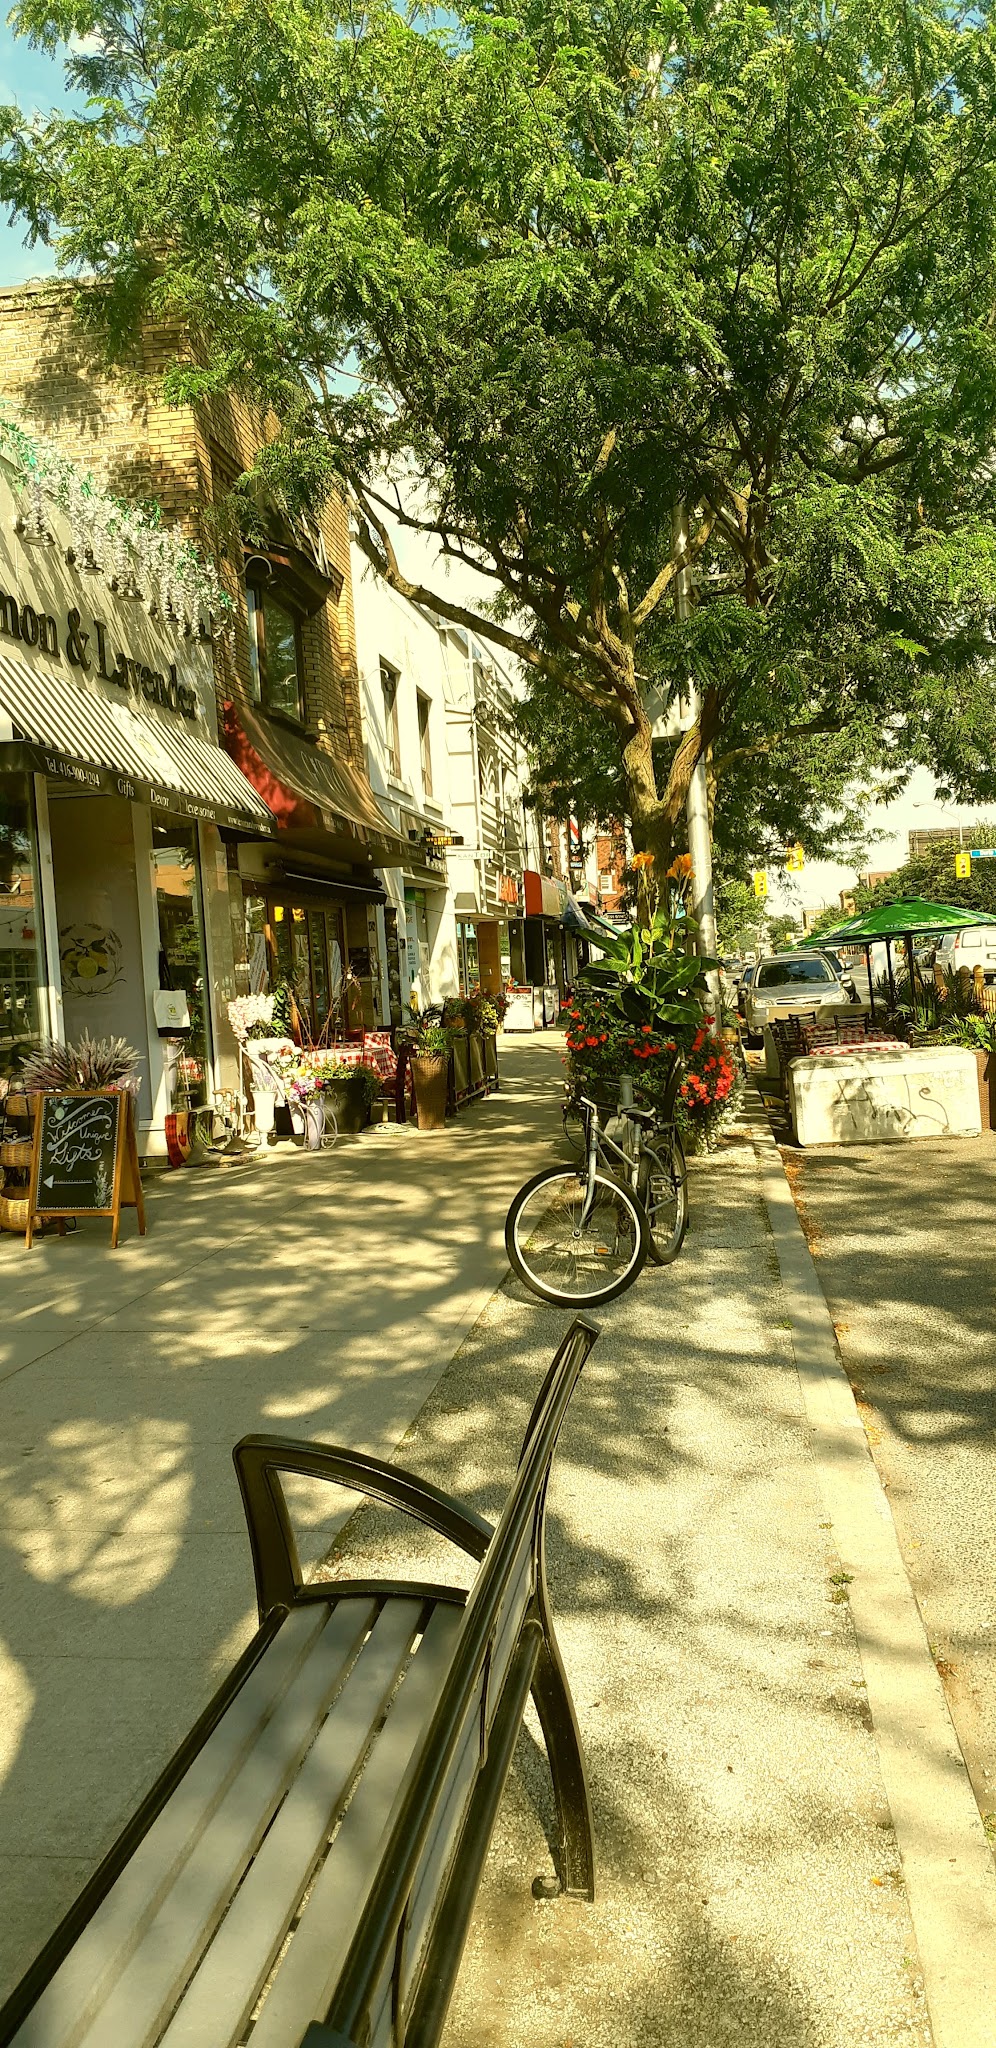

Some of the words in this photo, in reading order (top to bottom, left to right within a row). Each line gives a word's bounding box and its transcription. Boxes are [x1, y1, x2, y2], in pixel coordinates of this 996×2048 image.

[66, 608, 91, 671] &
[94, 620, 197, 721] Lavender
[117, 778, 135, 800] Gifts
[80, 1127, 112, 1145] Unique
[49, 1142, 102, 1172] Gifts
